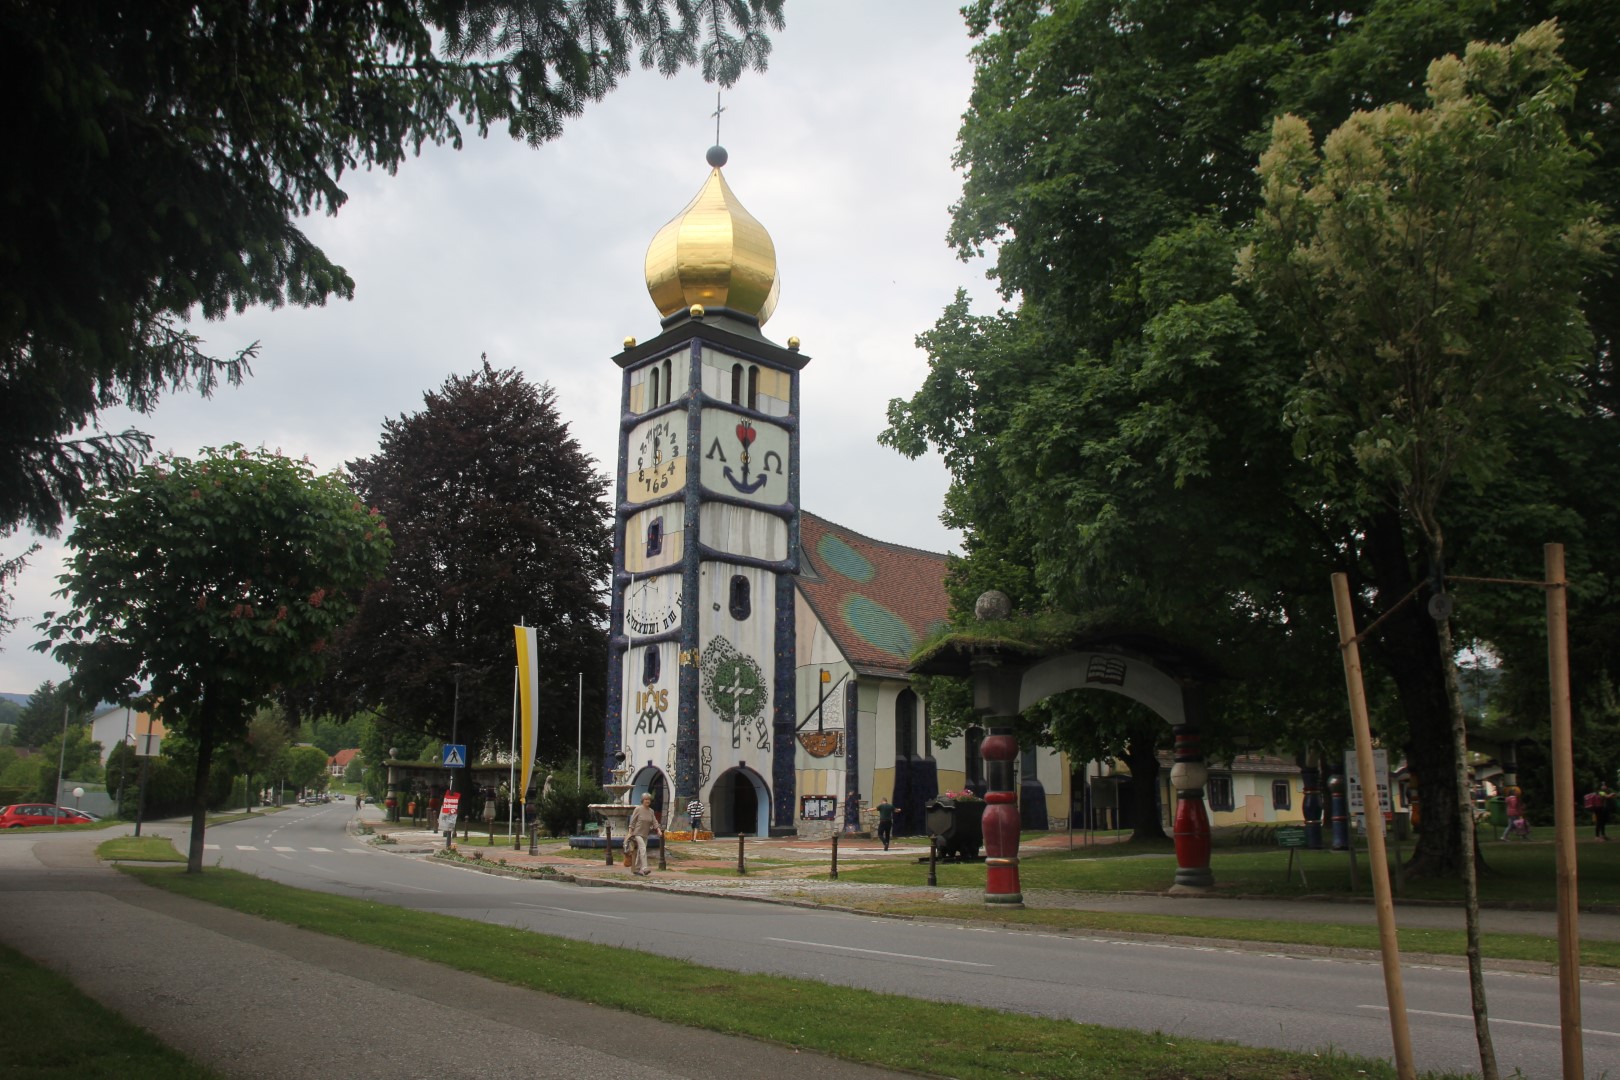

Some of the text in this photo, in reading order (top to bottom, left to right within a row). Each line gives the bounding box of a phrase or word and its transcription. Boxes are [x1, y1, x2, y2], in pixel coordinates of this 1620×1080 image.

[670, 432, 677, 445] 2
[672, 445, 679, 457] 3
[637, 456, 643, 470] 9
[667, 460, 676, 476] 4
[638, 469, 645, 483] 8
[660, 473, 669, 489] 5
[645, 478, 652, 492] 7
[652, 478, 659, 494] 6
